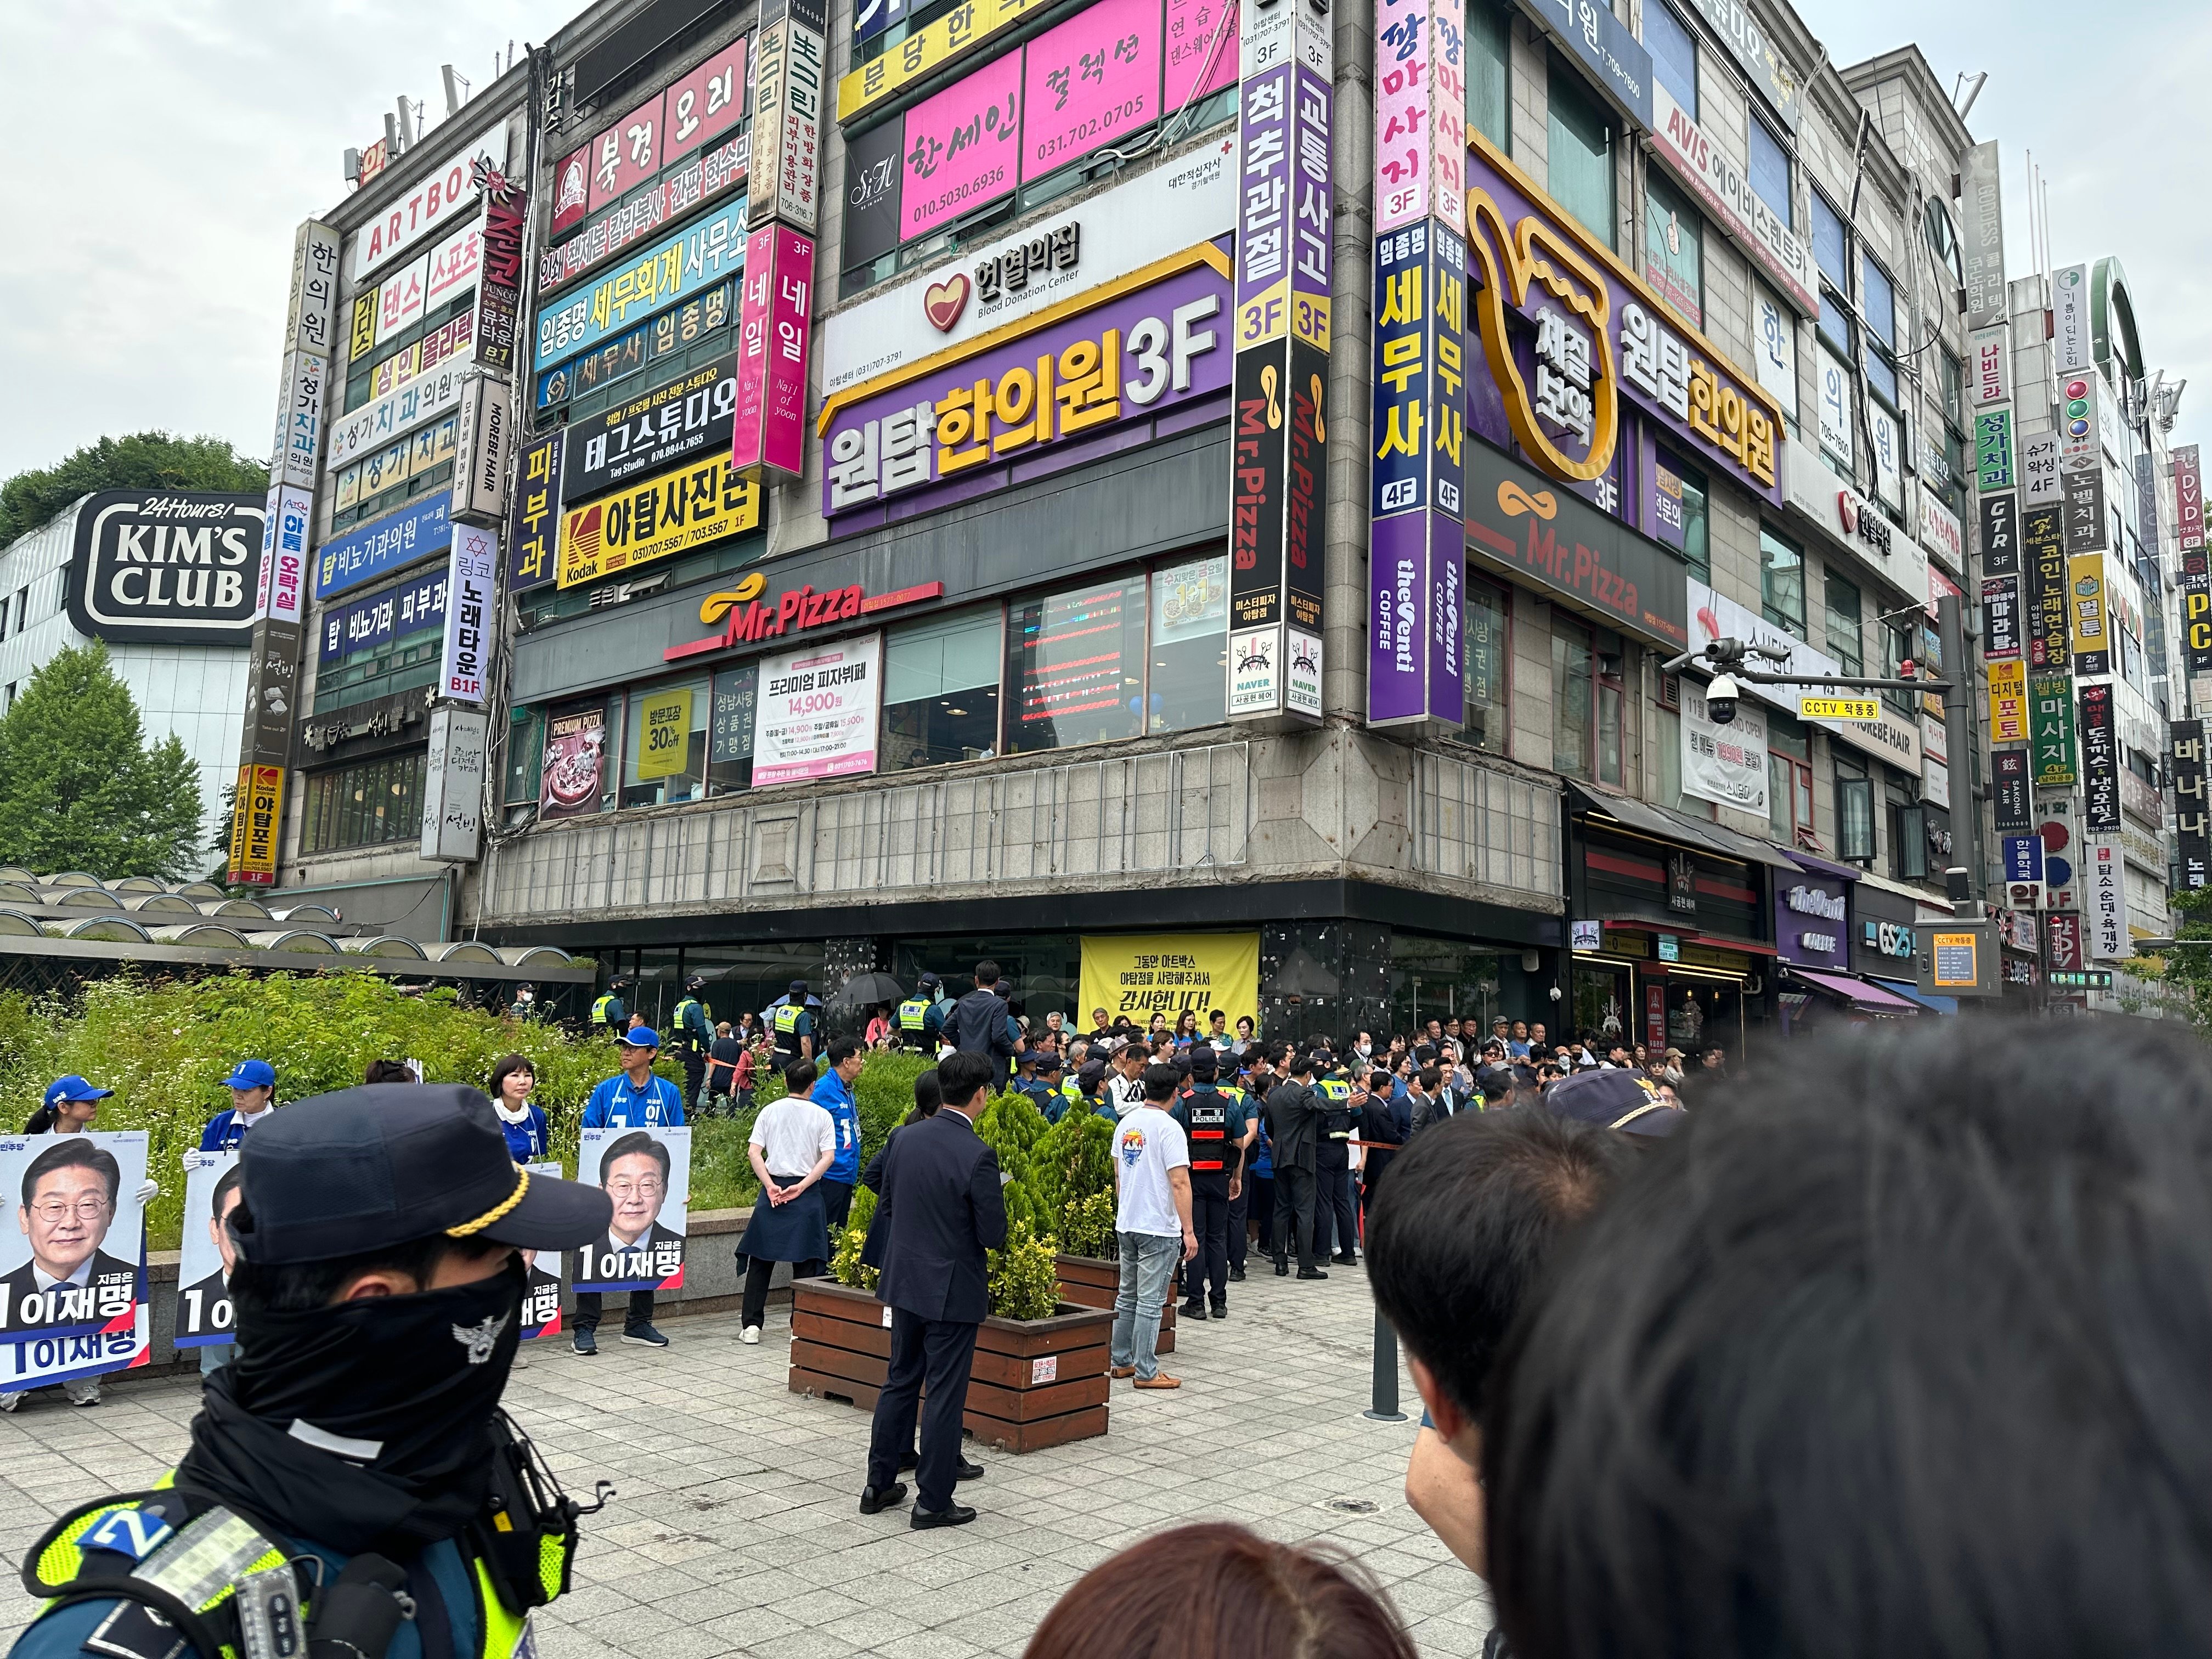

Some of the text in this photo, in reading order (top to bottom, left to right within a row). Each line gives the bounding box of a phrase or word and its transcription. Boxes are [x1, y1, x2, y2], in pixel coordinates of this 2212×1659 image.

[1254, 12, 1280, 31] 야탑센터
[1257, 43, 1278, 64] 3F
[1308, 45, 1323, 66] 3F
[907, 32, 1139, 180] 한세인 컬렉션
[1383, 60, 1426, 184] 마사지
[596, 64, 733, 194] 북경 오리
[1037, 95, 1144, 160] 031.702.0705
[1438, 62, 1464, 191] 마사지
[1667, 107, 1709, 172] AVIS
[1168, 156, 1222, 190] 대한적십자사
[1245, 75, 1285, 283] 척추관절
[1298, 78, 1329, 285] 교통사고
[368, 149, 485, 262] ARTBOX
[914, 165, 1004, 223] 010.5030.6936
[1391, 189, 1415, 215] 3F
[1442, 195, 1458, 213] 3F
[540, 160, 702, 286] 인쇄 간판
[1712, 153, 1808, 284] 에이비스렌트카
[758, 234, 770, 250] 3F
[793, 241, 810, 256] 3F
[1380, 226, 1425, 266] 임종명
[1436, 228, 1464, 271] 임종명
[975, 221, 1080, 303] 헌혈의집
[286, 240, 305, 345] 한의원
[302, 241, 336, 347] 한의원
[384, 233, 478, 330] 댄스 스포츠
[484, 284, 517, 301] JUNCO
[978, 268, 1079, 319] Blood Donation Center
[354, 295, 374, 357] 가디스
[482, 308, 513, 331] 뮤직
[540, 297, 588, 358] 임종명
[657, 286, 725, 353] 임종명
[745, 272, 768, 358] 네일
[778, 275, 806, 364] 네일
[1244, 298, 1283, 341] 3F
[1298, 301, 1327, 341] 3F
[481, 324, 512, 347] 타운
[1126, 294, 1220, 405] 3F
[378, 312, 473, 397] 성인 콜라텍
[485, 346, 508, 362] B1
[1377, 268, 1424, 460] 세무사
[1435, 268, 1462, 467] 세무사
[1981, 343, 2001, 399] 나비드라
[651, 392, 667, 408] 사진
[743, 377, 758, 393] Nail
[777, 379, 797, 396] Nail
[781, 396, 791, 405] of
[775, 407, 797, 421] yoon
[483, 402, 503, 493] MOREBE HAIR
[610, 433, 704, 478] Tag Studio 070.8844.7655
[1820, 420, 1849, 458] 709-7600
[1978, 415, 2011, 486] 성가치과
[2028, 441, 2055, 458] 슈가
[290, 452, 313, 467] 의원
[2028, 458, 2055, 472] 왁싱
[1235, 399, 1266, 570] Mr.Pizza
[1291, 391, 1312, 569] Mr.Pizza
[1387, 483, 1412, 505] 4F
[1442, 484, 1456, 507] 4F
[1595, 477, 1617, 515] 3F
[2031, 478, 2054, 493] 4F
[2182, 475, 2198, 520] DVD
[139, 497, 235, 519] 24Hours!
[518, 441, 551, 578] 피부과
[2072, 473, 2097, 539] 노벨치과
[691, 515, 745, 544] 703.5567 1F
[1991, 500, 2007, 549] GTR
[2186, 538, 2199, 546] 3F
[114, 524, 248, 566] KIM'S
[1994, 555, 2008, 566] 3F
[276, 555, 299, 611] 오락실
[459, 556, 492, 580] 링코
[567, 560, 598, 584] Kodak
[1527, 517, 1638, 617] Mr.Pizza
[2186, 574, 2207, 583] 크루
[111, 567, 243, 608] CLUB
[1176, 578, 1207, 607] 1+1
[1235, 595, 1276, 611] 미스터피자
[328, 583, 447, 652] 탑 비뇨기과 피부과
[455, 580, 483, 676] 노래타운
[727, 585, 864, 646] Mr.Pizza
[1243, 608, 1267, 621] 야탑점
[1379, 590, 1391, 650] COFFEE
[1993, 603, 2010, 650] 마라탕
[2077, 599, 2101, 637] 벌툰
[2188, 594, 2211, 650] PC
[2086, 655, 2097, 663] 2F
[450, 677, 479, 694] B1F
[769, 673, 814, 697] 프리미엄
[817, 662, 866, 688] 피자뷔페
[1237, 680, 1269, 692] NAVER
[1292, 679, 1316, 694] NAVER
[1991, 680, 2023, 697] 디지털
[649, 704, 681, 725] 방문포장
[718, 691, 753, 708] 성남사랑
[788, 692, 842, 717] 14,900원
[1805, 702, 1874, 716] CCTV 작동중
[552, 713, 601, 736] PREMIUM PIZZA
[1746, 720, 1762, 740] OPEN
[1997, 699, 2021, 739] 포토
[2041, 698, 2068, 763] 마사지
[1889, 731, 1910, 756] HAIR
[2001, 781, 2010, 805] HAIR
[2012, 780, 2021, 815] SAKONG
[2174, 738, 2208, 837] 바나나
[250, 796, 274, 859] 야탑포토
[251, 873, 262, 881] 1F
[2011, 884, 2039, 909] 약
[1803, 933, 1836, 952] COFFEE
[1879, 922, 1911, 958] GS25
[1120, 972, 1210, 986] 야탑점을 사랑해주셔서
[1134, 955, 1195, 968] 그동안 아트박스
[1120, 990, 1211, 1013] 감사합니다!
[655, 1241, 681, 1251] 지금은
[98, 1272, 133, 1285] 지금은
[601, 1251, 681, 1278] 이재명
[20, 1285, 133, 1325] 이재명
[534, 1284, 558, 1296] 지금은
